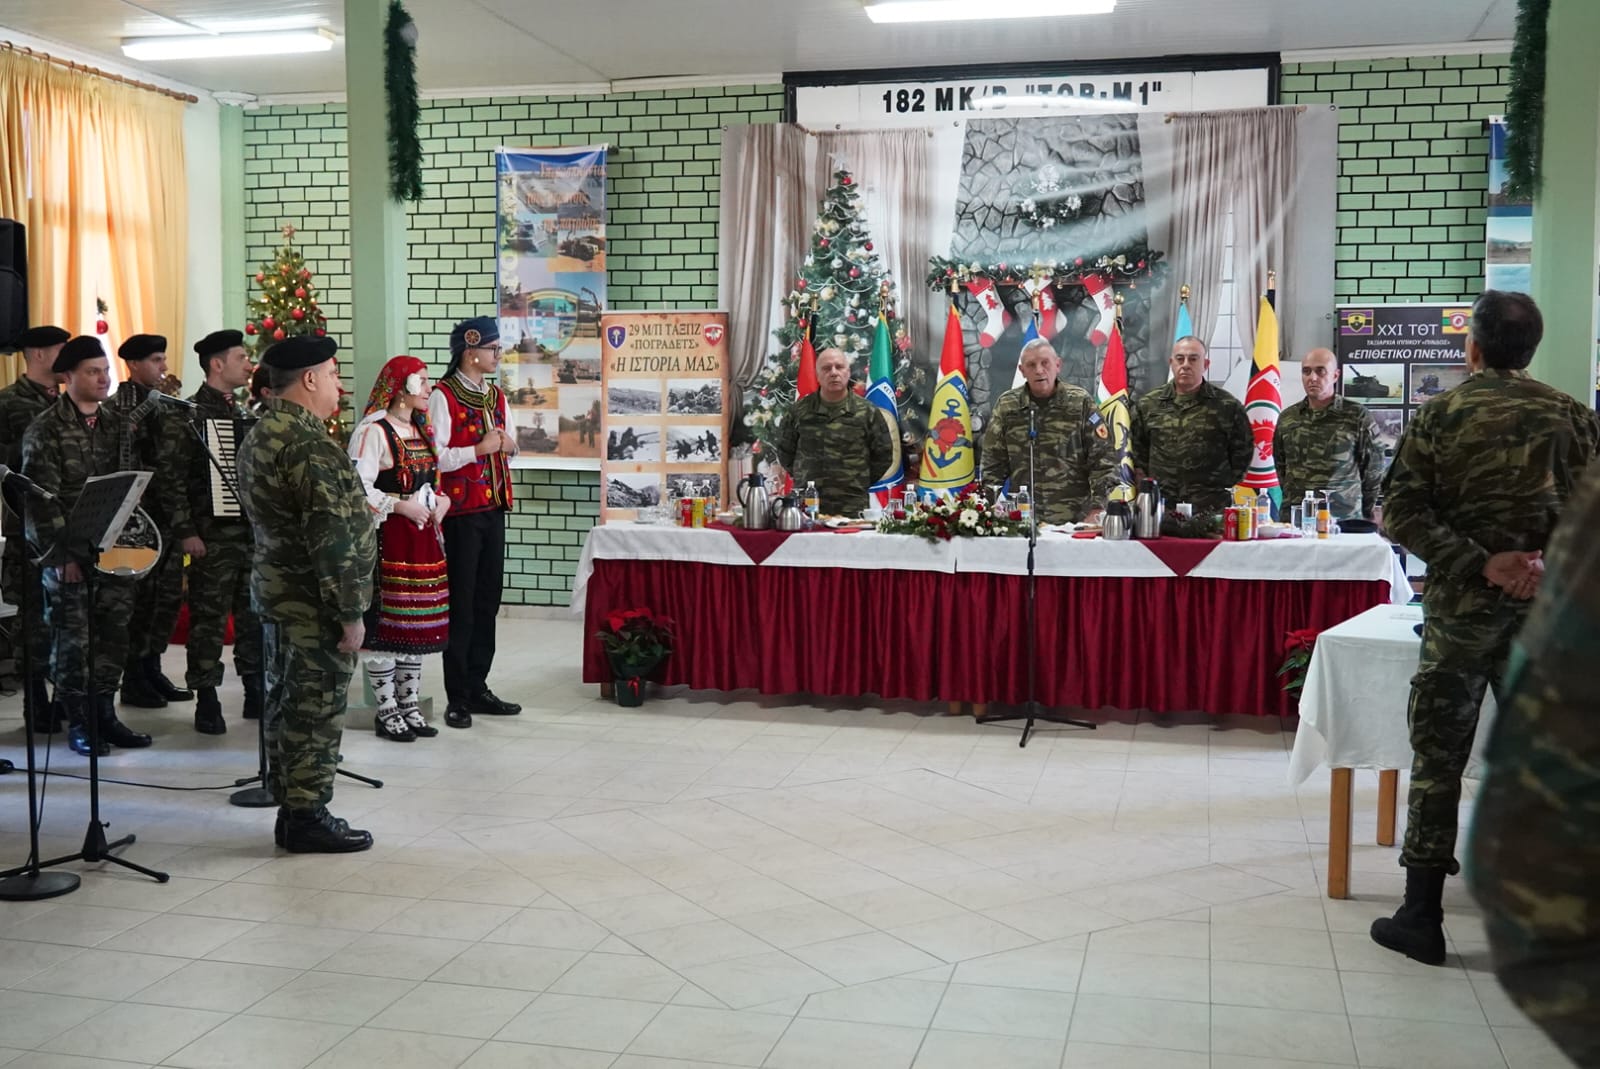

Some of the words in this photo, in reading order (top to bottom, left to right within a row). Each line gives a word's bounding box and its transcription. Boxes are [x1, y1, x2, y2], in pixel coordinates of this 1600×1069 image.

[883, 88, 925, 113] 182
[629, 324, 640, 336] 29
[1408, 323, 1439, 336] ΤΘΤ
[630, 339, 700, 350] «ΠΟΓΡΑΔΕΤΣ»
[1348, 349, 1411, 360] «ΕΠΙΘΕΤΙΚΟ
[1413, 348, 1466, 359] ΠΝΕΥΜΑ»
[610, 356, 626, 372] «Η
[629, 356, 680, 372] ΙΣΤΟΡΙΑ
[684, 356, 720, 372] ΜΑΣ»
